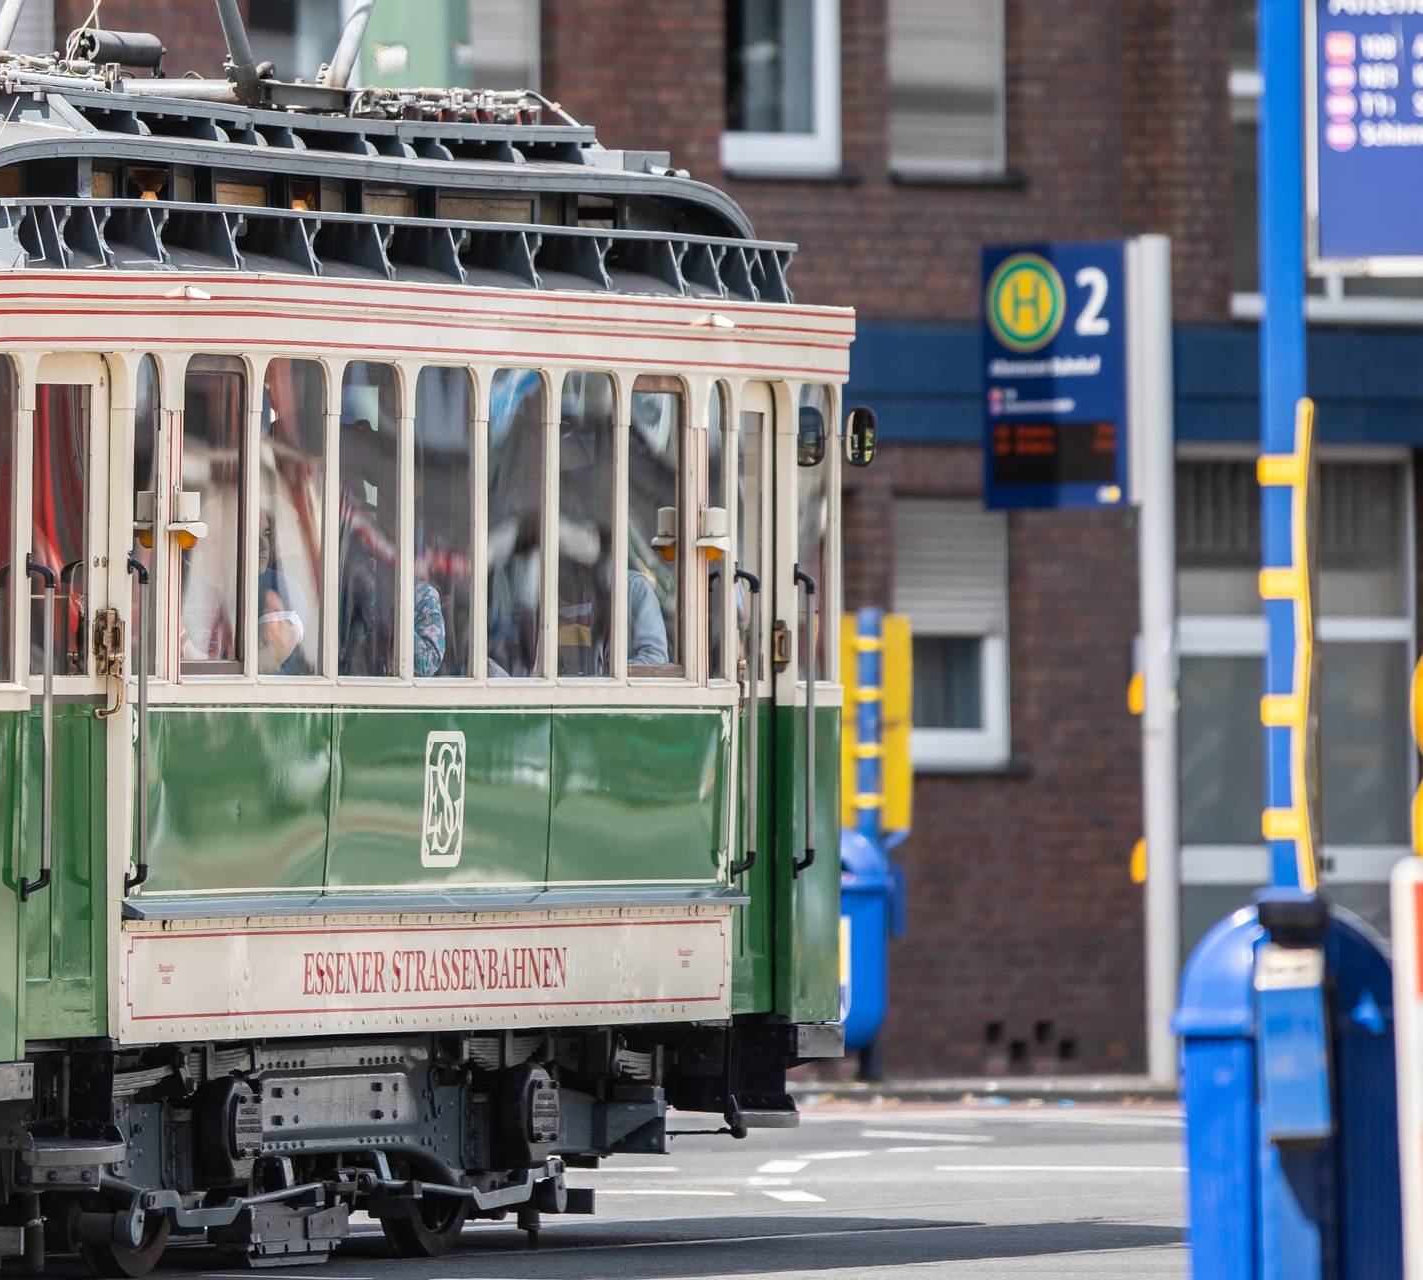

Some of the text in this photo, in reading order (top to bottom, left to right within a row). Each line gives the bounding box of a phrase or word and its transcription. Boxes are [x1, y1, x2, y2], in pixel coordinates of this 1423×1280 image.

[1075, 266, 1110, 336] 2
[303, 946, 568, 996] ESSENER STRASSENBAHNEN
